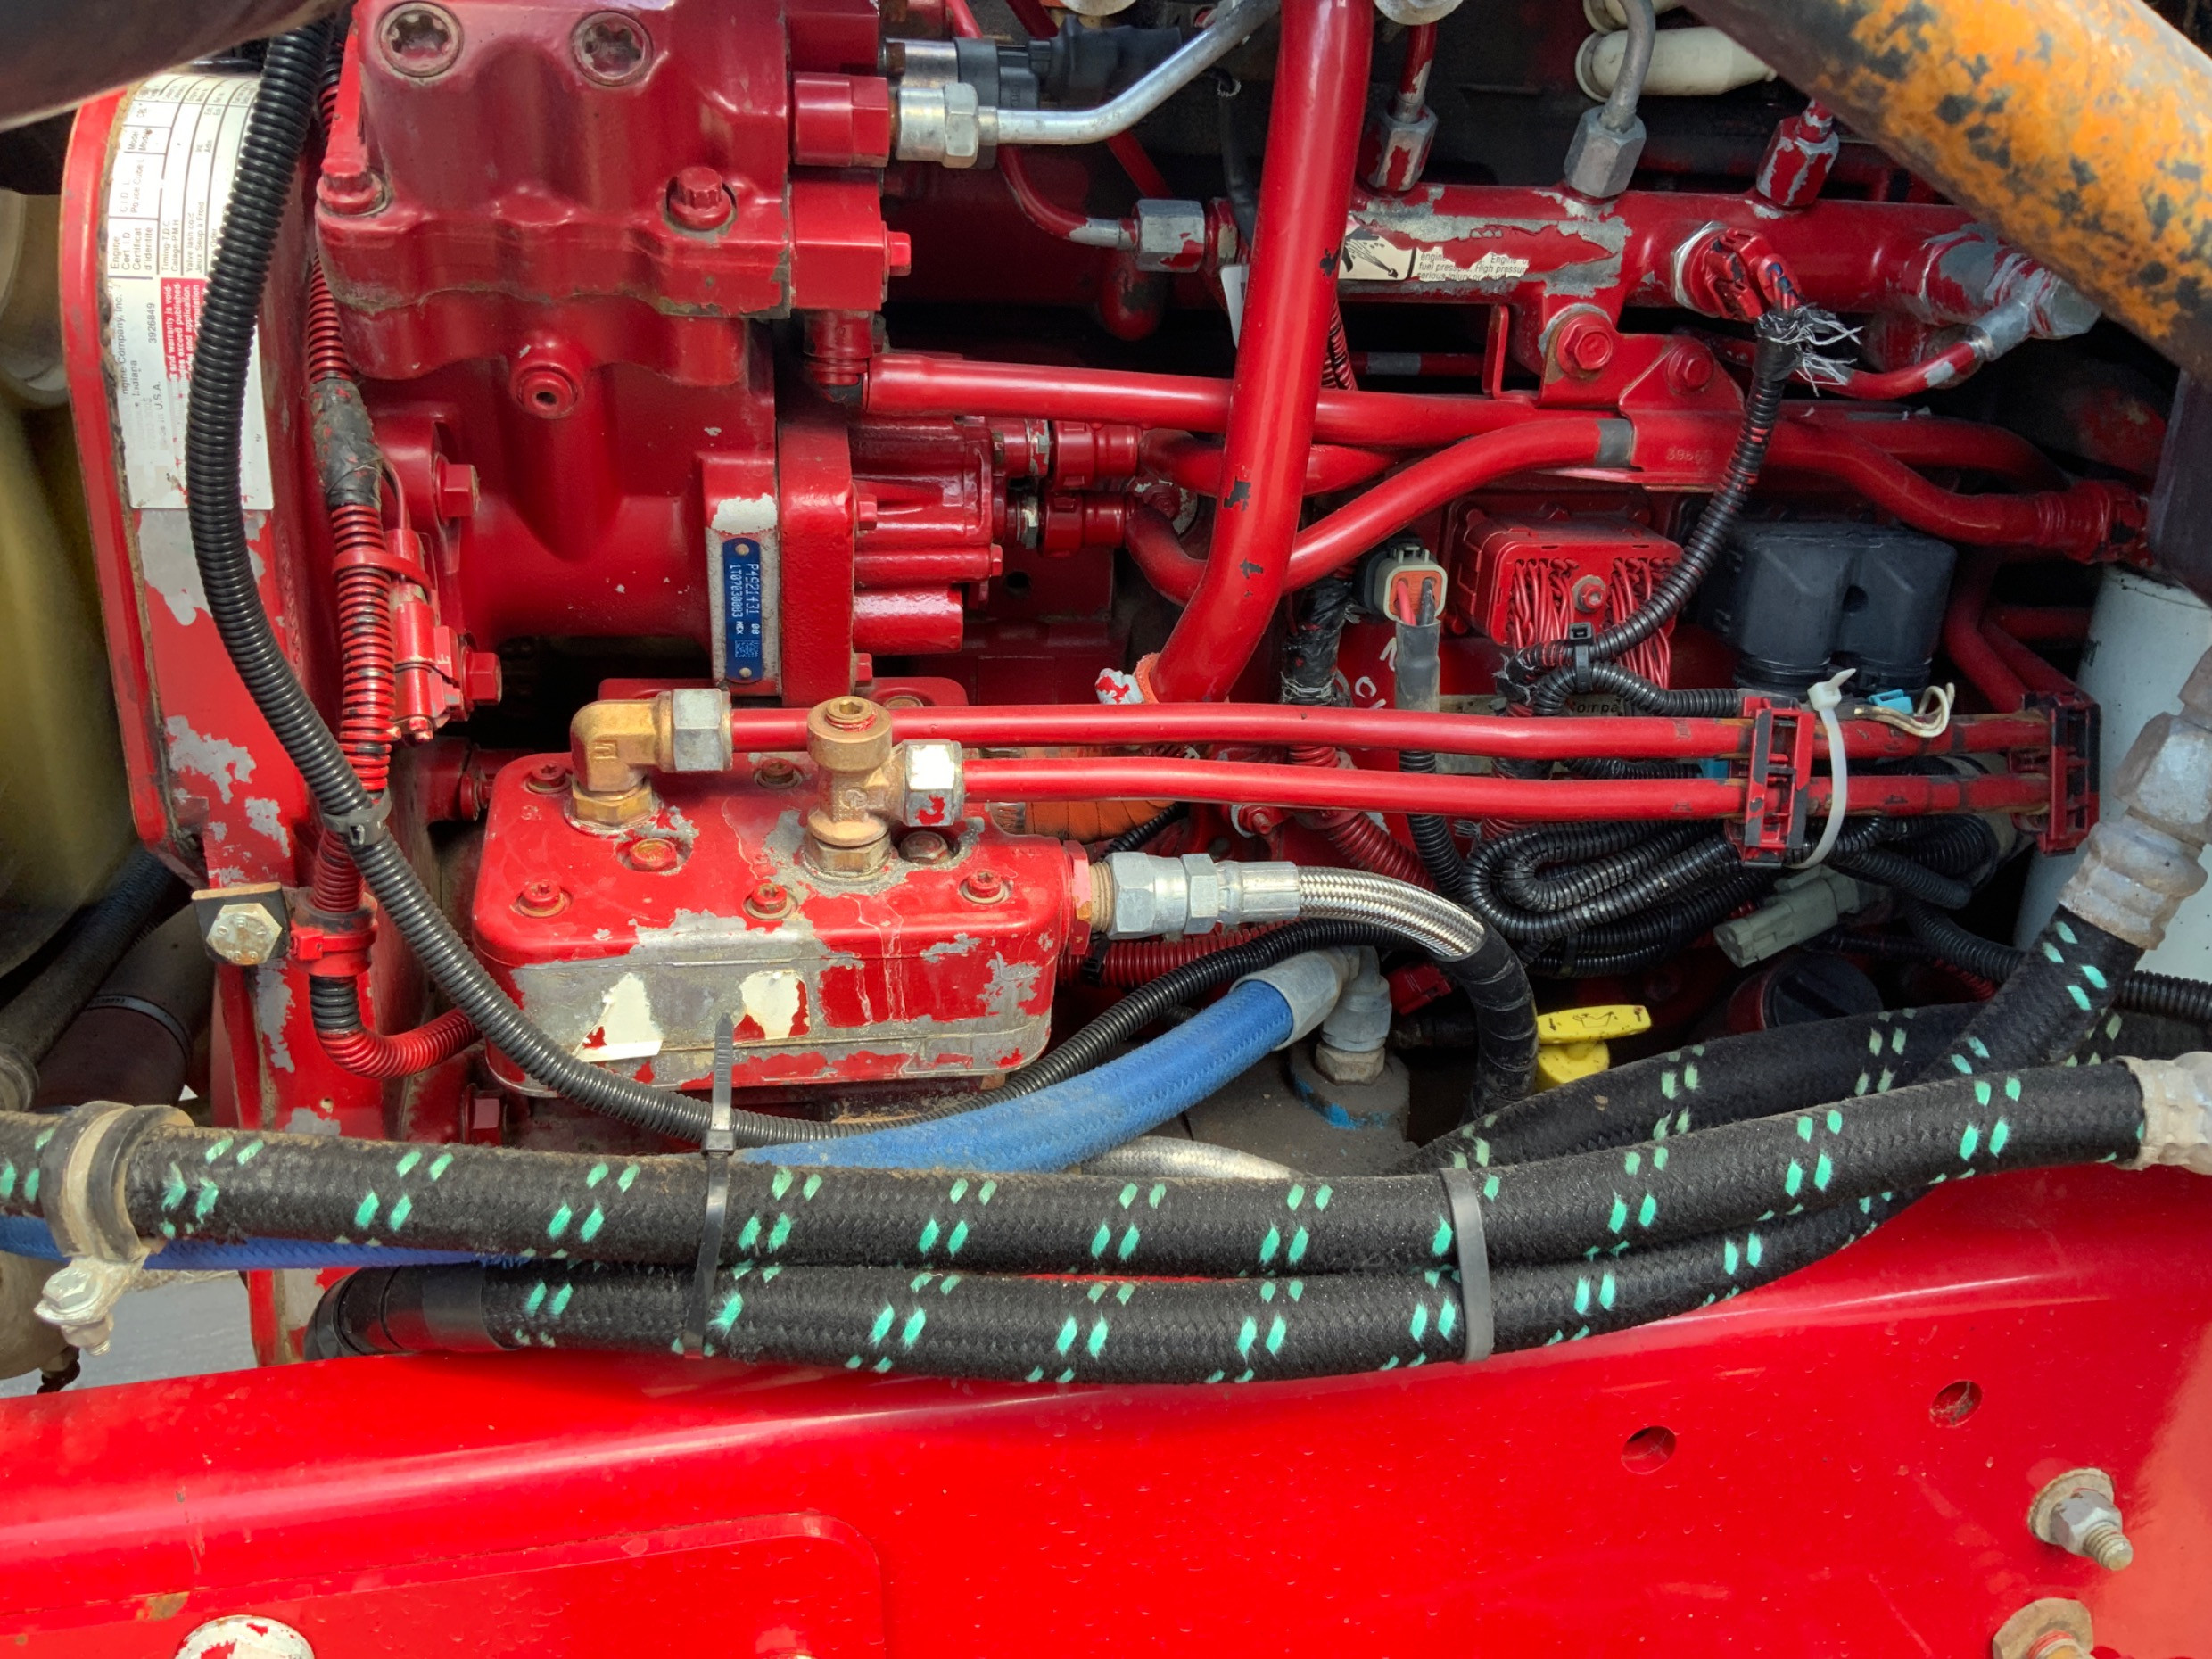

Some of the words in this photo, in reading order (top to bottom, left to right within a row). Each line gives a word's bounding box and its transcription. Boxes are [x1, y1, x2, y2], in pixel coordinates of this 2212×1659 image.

[111, 236, 121, 269] Engine
[133, 227, 141, 270] Certificat
[146, 302, 157, 343] 3926849
[167, 317, 175, 353] warranty
[175, 327, 184, 357] exceed
[120, 367, 130, 394] ngine
